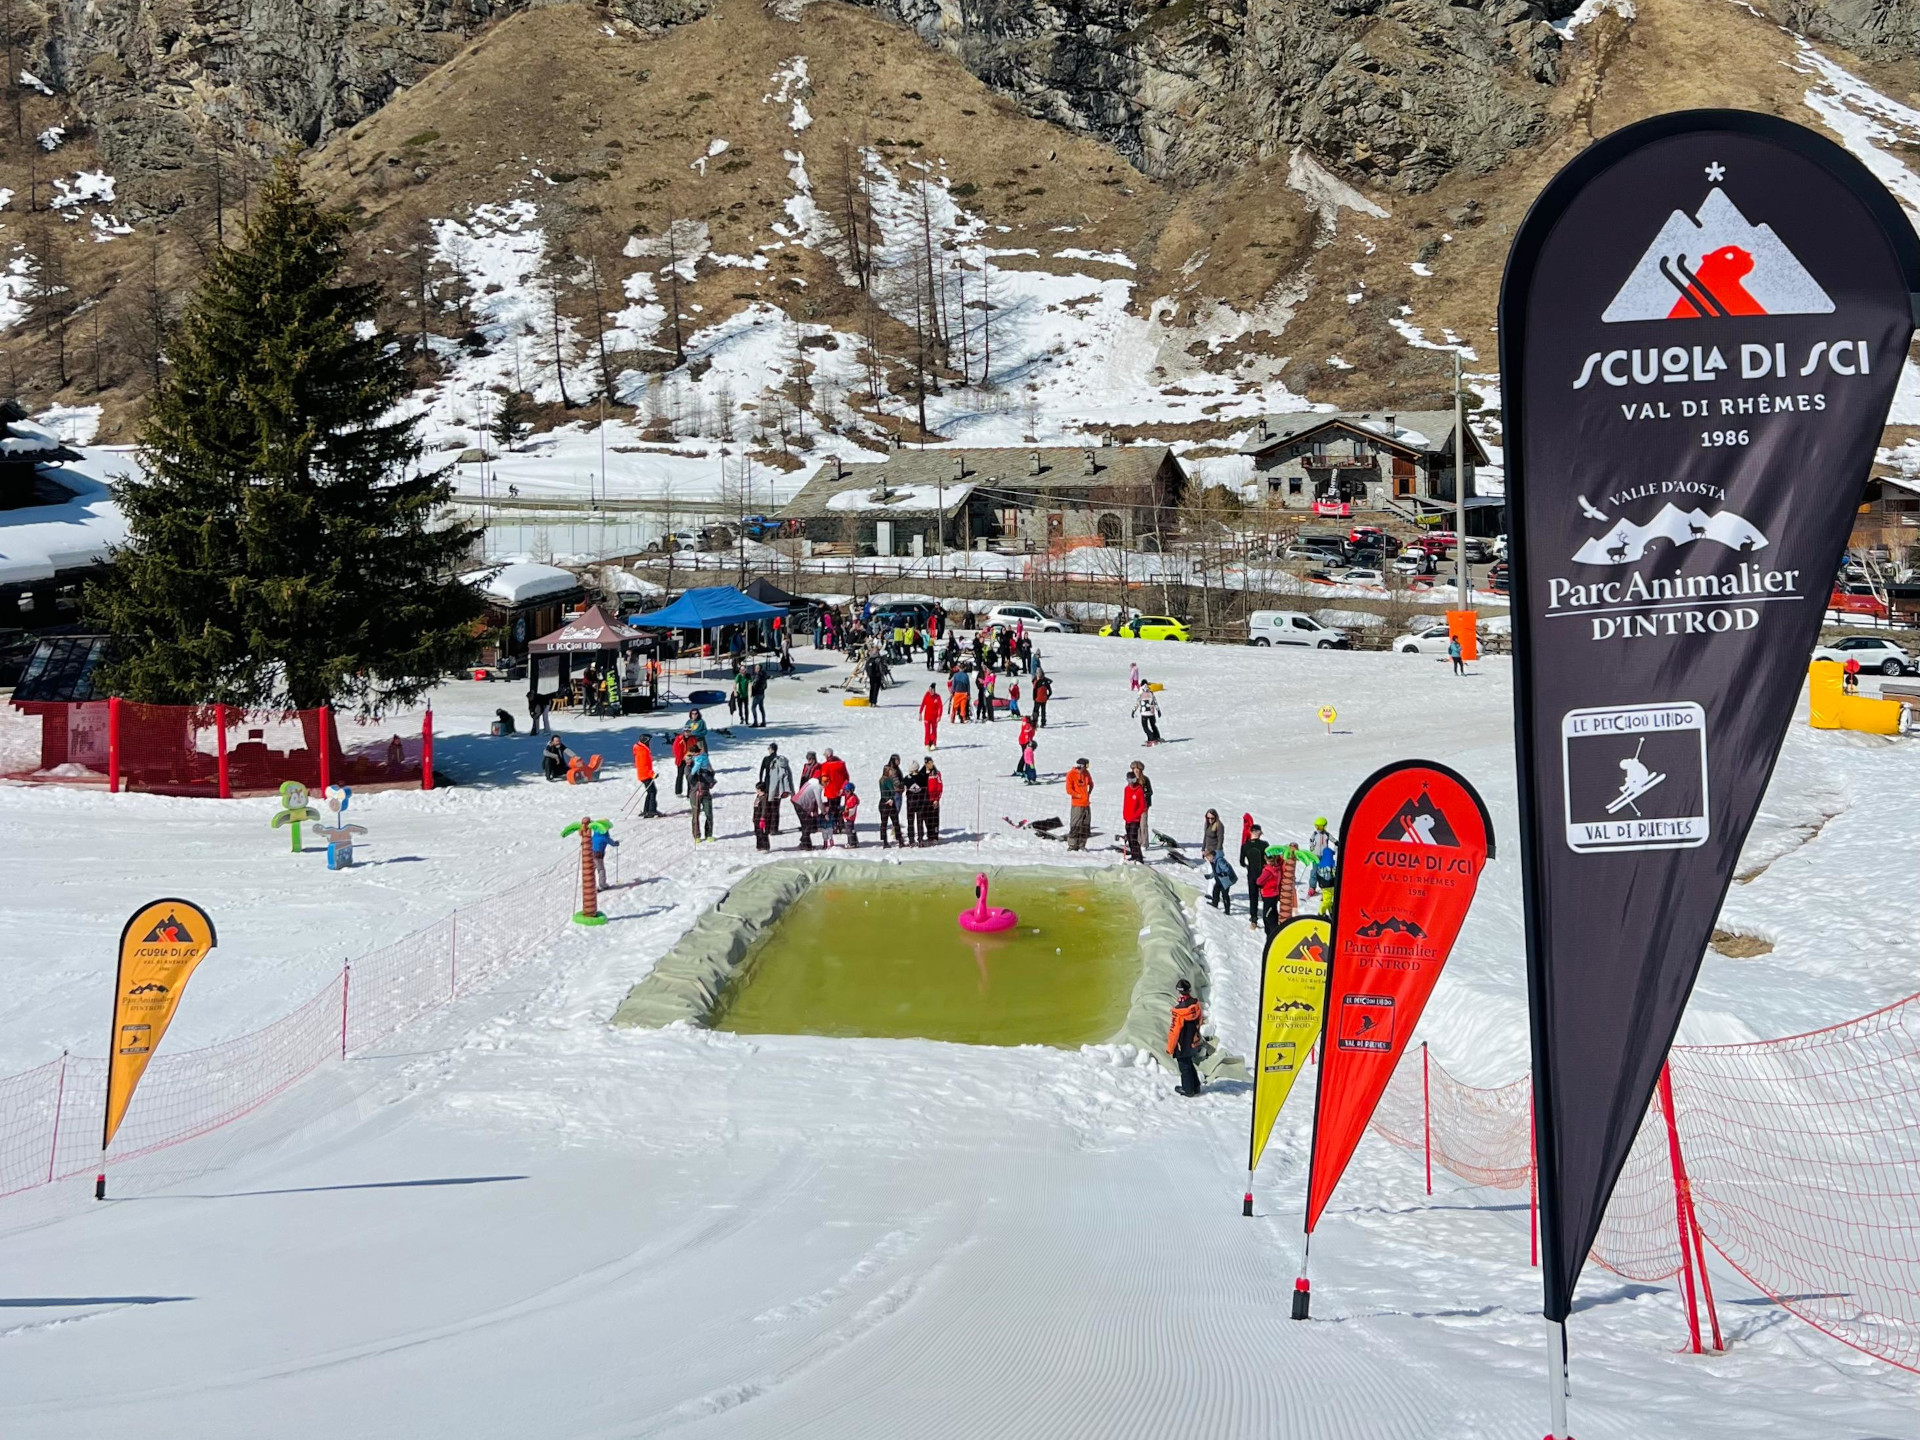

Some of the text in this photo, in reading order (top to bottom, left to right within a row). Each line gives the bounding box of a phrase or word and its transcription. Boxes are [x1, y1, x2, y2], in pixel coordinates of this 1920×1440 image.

[1572, 340, 1871, 390] SCUOLA DI SCI
[1621, 393, 1827, 421] VAL DI RHÊMES
[1701, 429, 1750, 447] 1986
[1609, 480, 1726, 506] VALLE D'AOSTA
[1592, 607, 1760, 641] D'INTROD
[1573, 718, 1588, 733] LE
[1654, 712, 1693, 728] LINDO
[1585, 824, 1611, 840] VAL
[1617, 823, 1632, 838] DI
[1363, 851, 1471, 875] SCUOLA DI SCI
[1380, 873, 1399, 882] VAL
[1402, 874, 1413, 883] DI
[134, 948, 168, 957] SCUOLA
[170, 948, 181, 957] DI
[1277, 965, 1327, 977] SCUOLA DI
